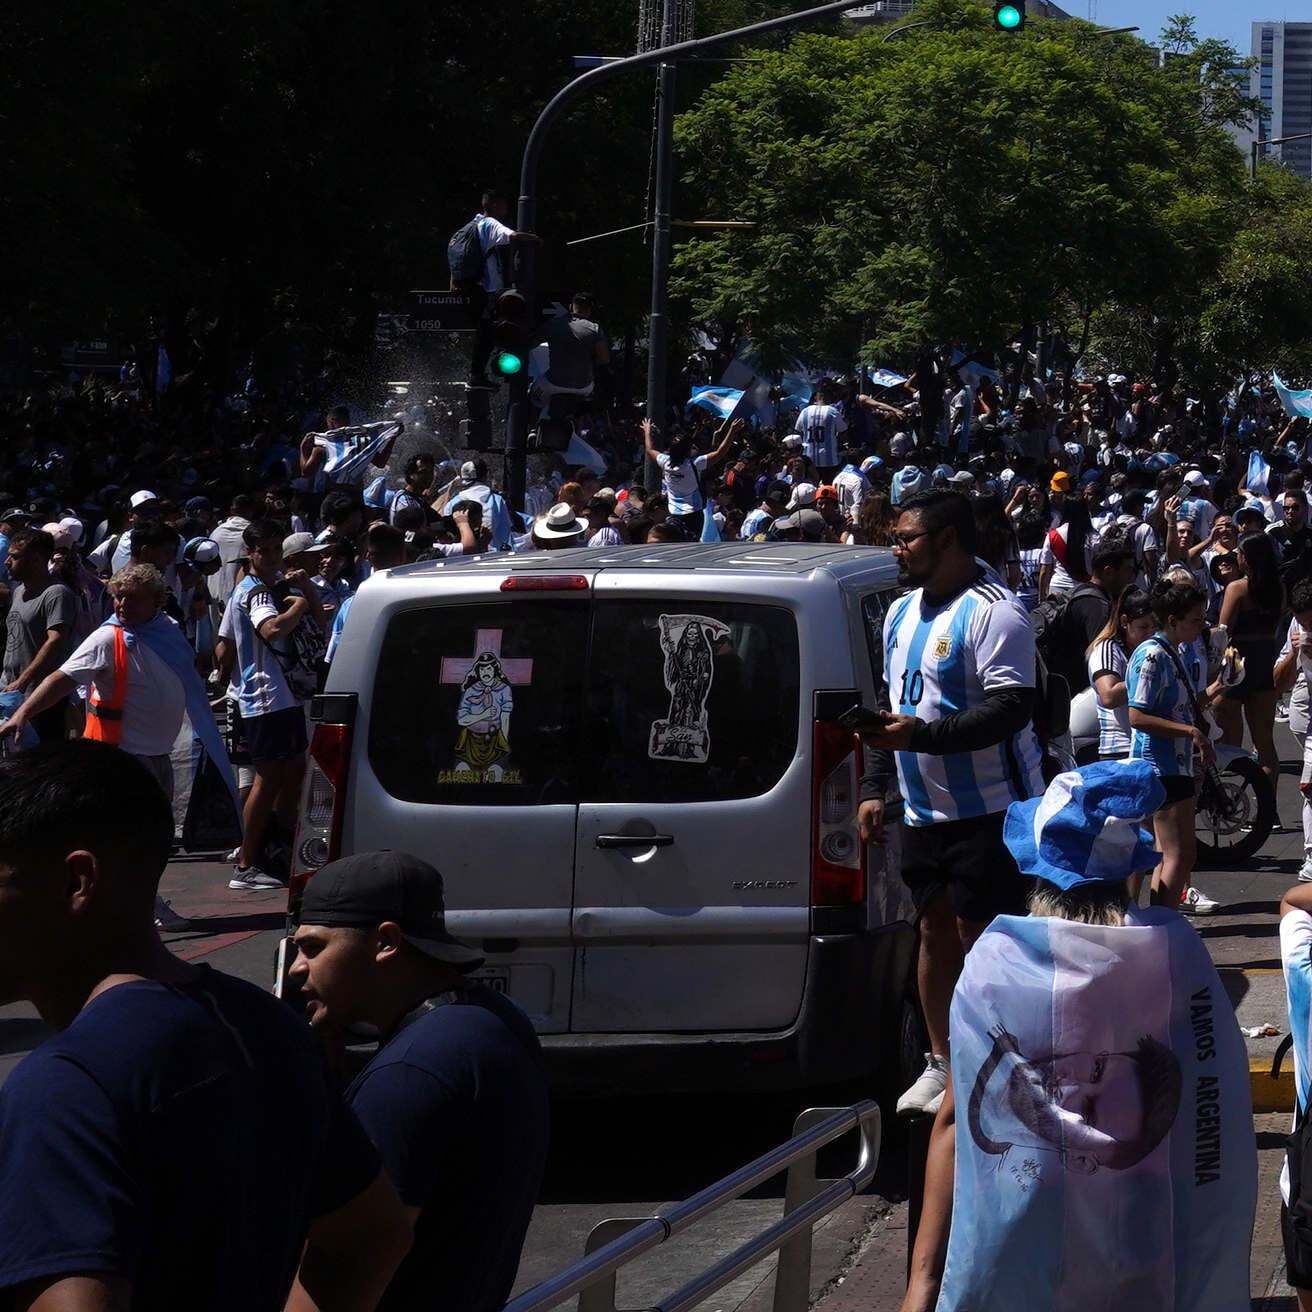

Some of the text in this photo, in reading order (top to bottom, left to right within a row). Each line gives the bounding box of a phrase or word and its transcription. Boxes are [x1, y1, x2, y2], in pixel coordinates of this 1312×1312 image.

[808, 426, 825, 443] 10
[899, 669, 924, 706] 10
[1191, 987, 1221, 1187] VAMOS ARGENTINA
